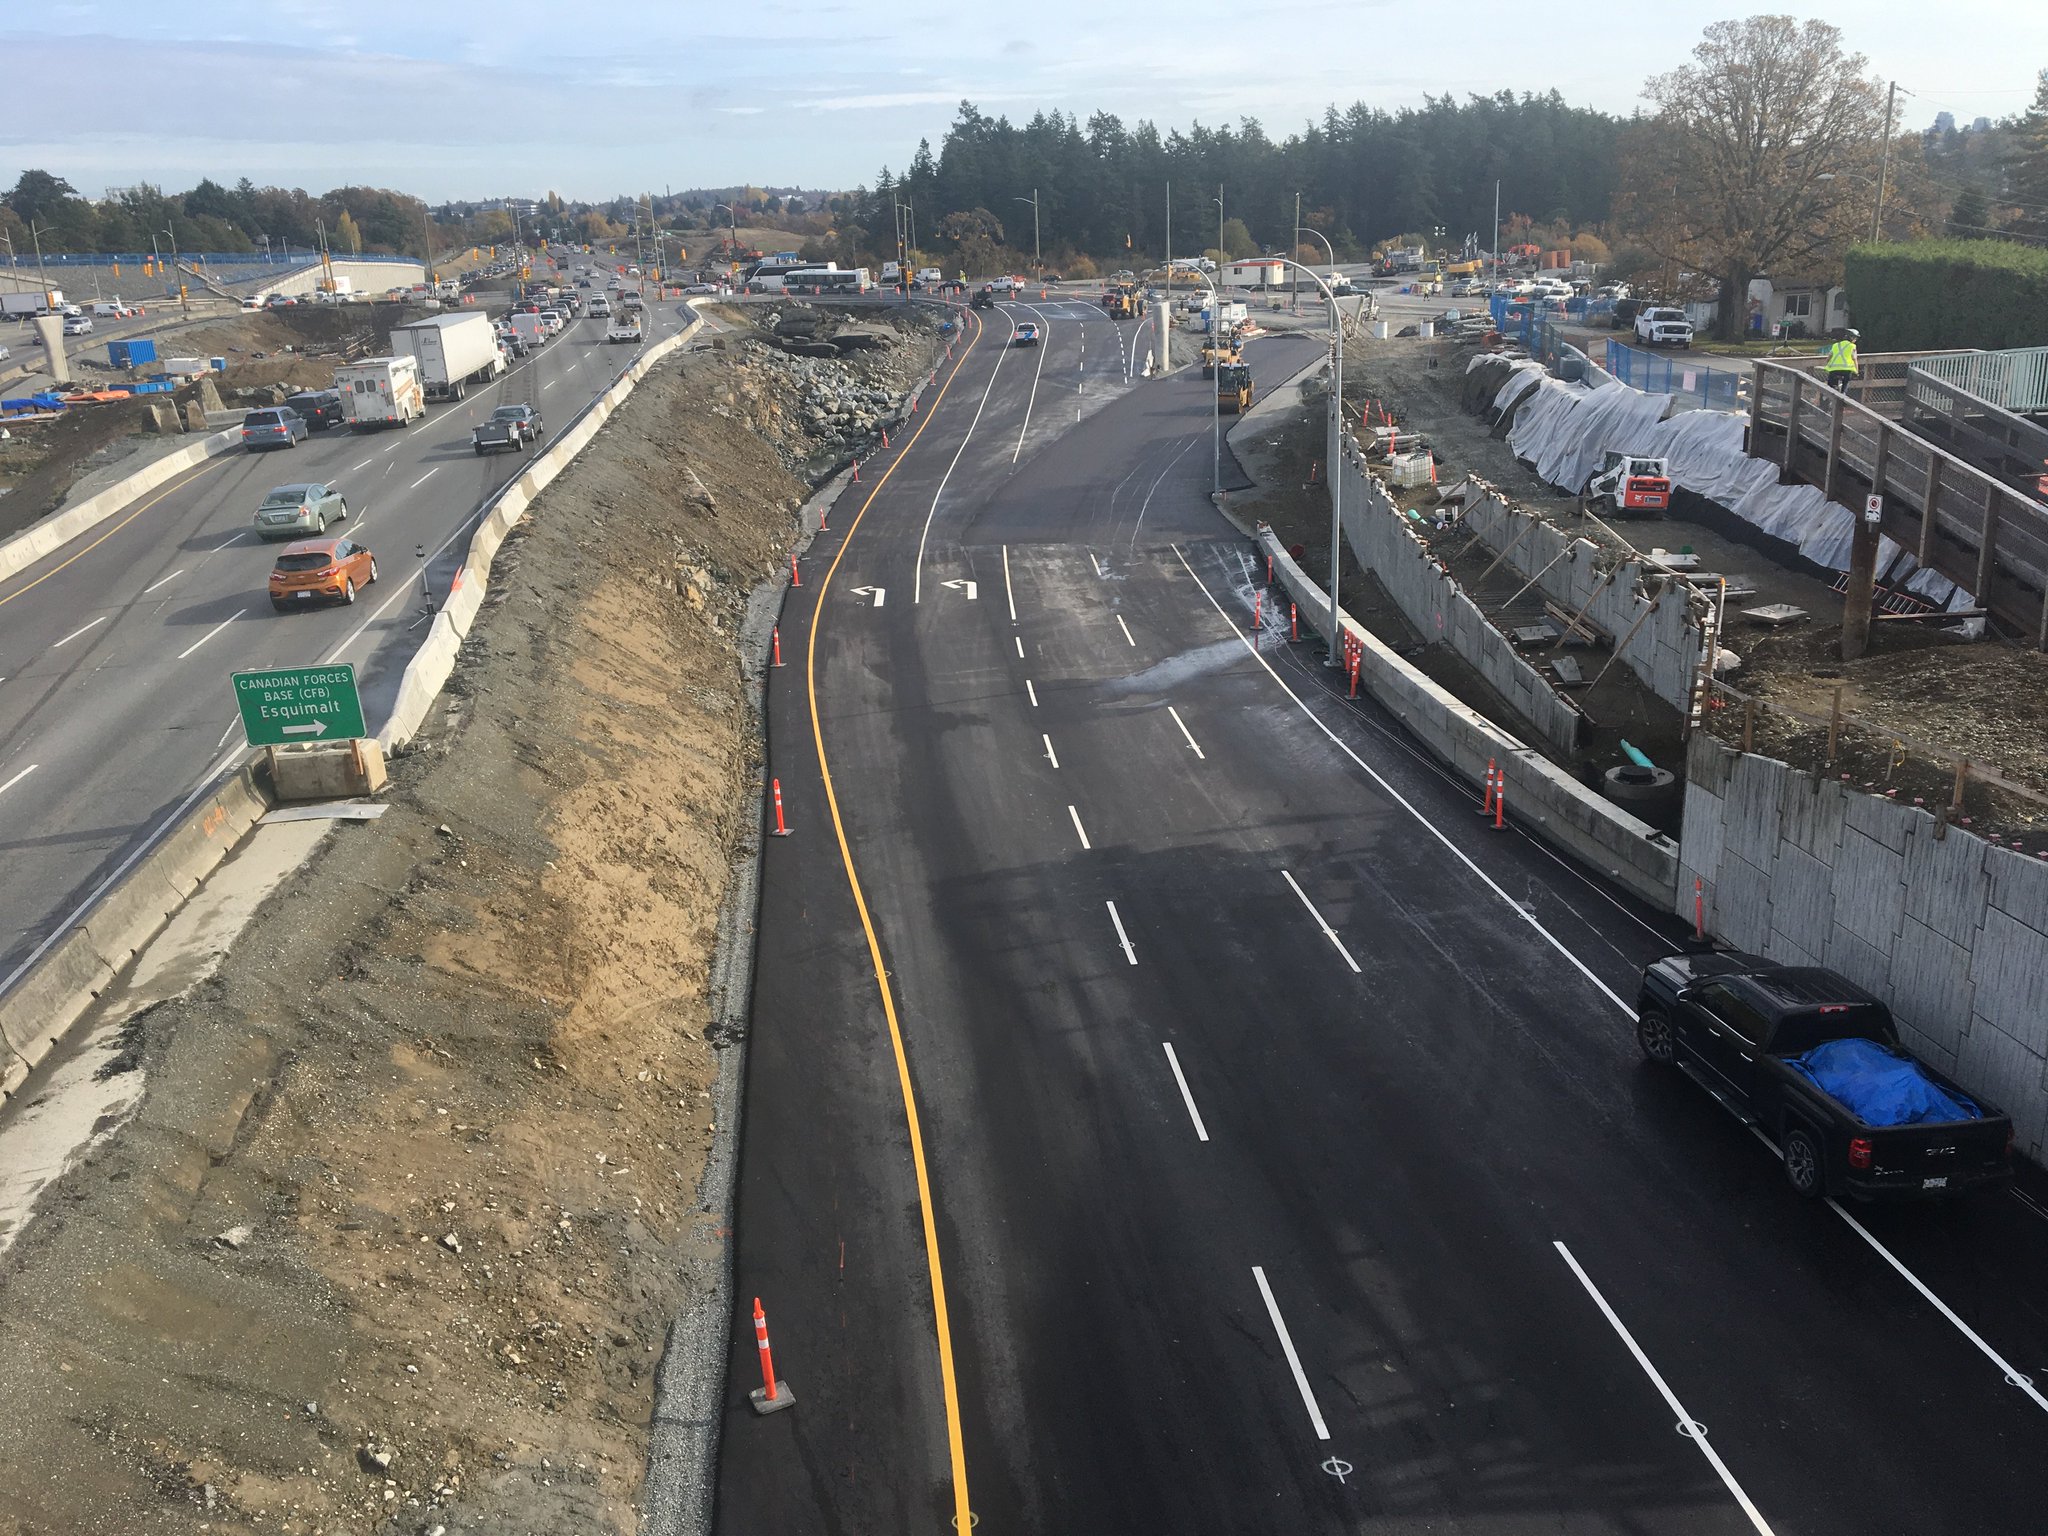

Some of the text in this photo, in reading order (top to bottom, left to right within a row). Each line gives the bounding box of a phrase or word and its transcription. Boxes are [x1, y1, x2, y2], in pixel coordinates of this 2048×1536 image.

[239, 672, 349, 690] CANADIAN FORCES
[264, 686, 330, 702] BASE (CFB)
[260, 700, 341, 719] Esquimalt
